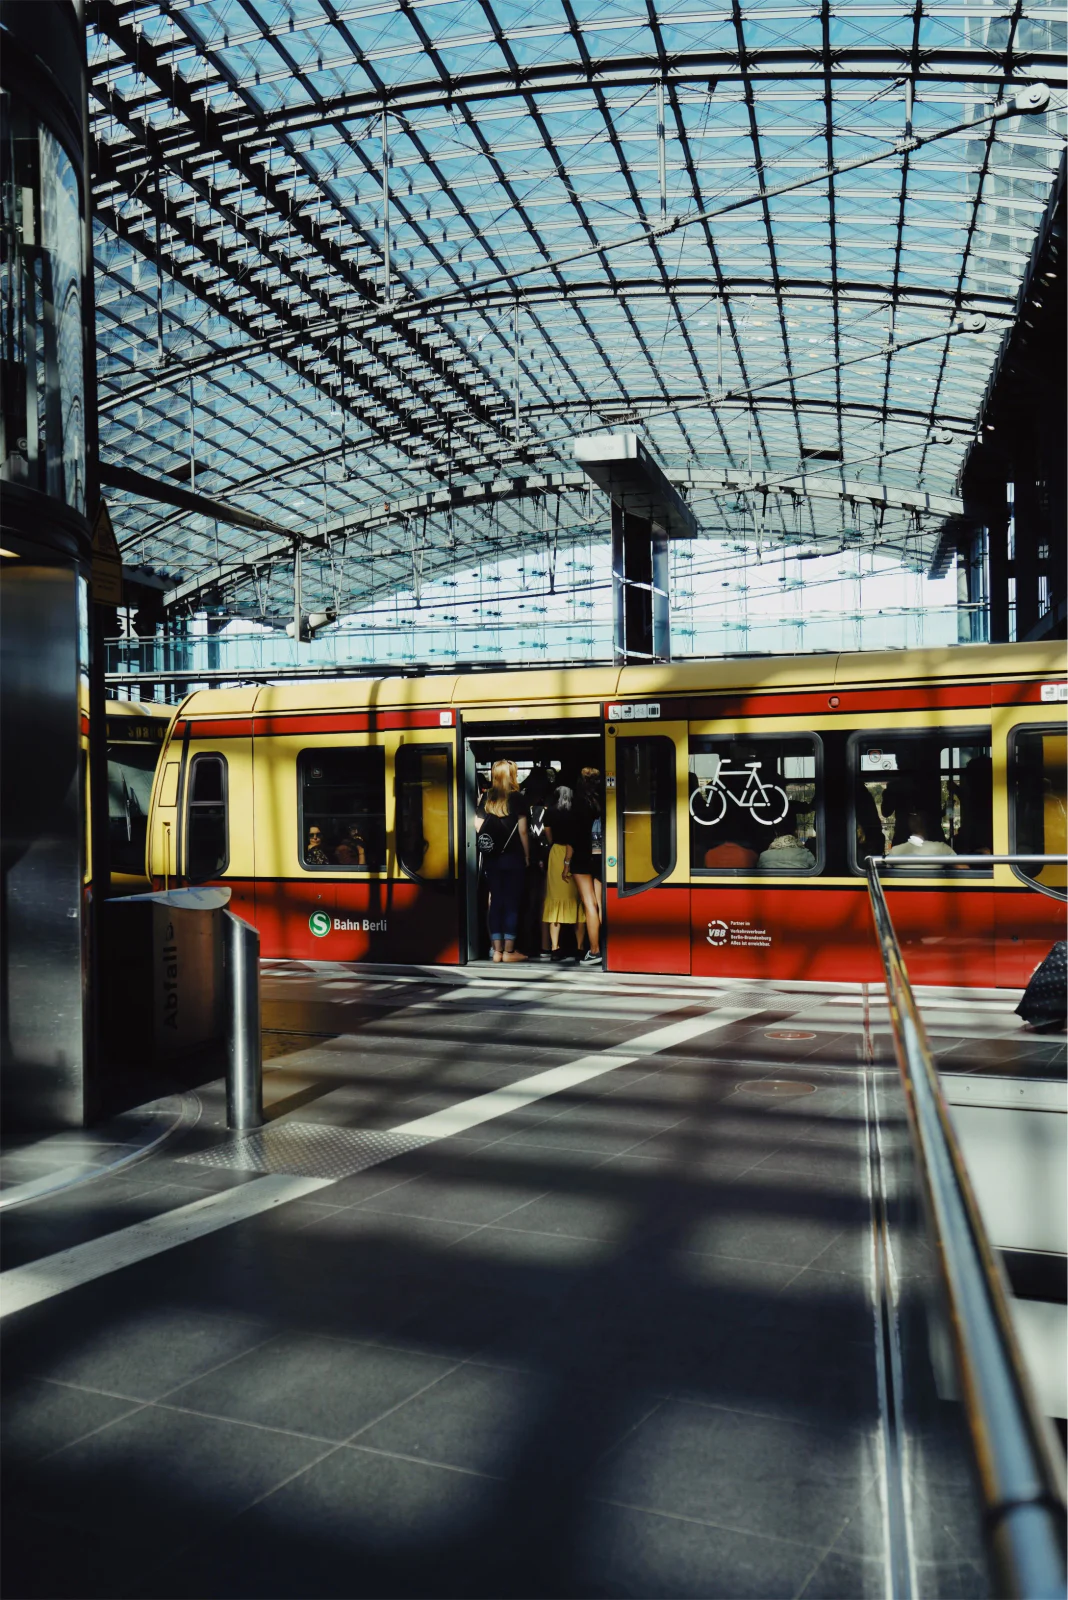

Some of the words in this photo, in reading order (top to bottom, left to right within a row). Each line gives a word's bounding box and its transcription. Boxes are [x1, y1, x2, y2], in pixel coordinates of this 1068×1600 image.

[312, 913, 328, 935] S
[333, 918, 360, 931] Bahn
[708, 928, 726, 938] VBB
[730, 934, 772, 942] Berlin-Brandenburg
[163, 946, 178, 1031] Abfall
